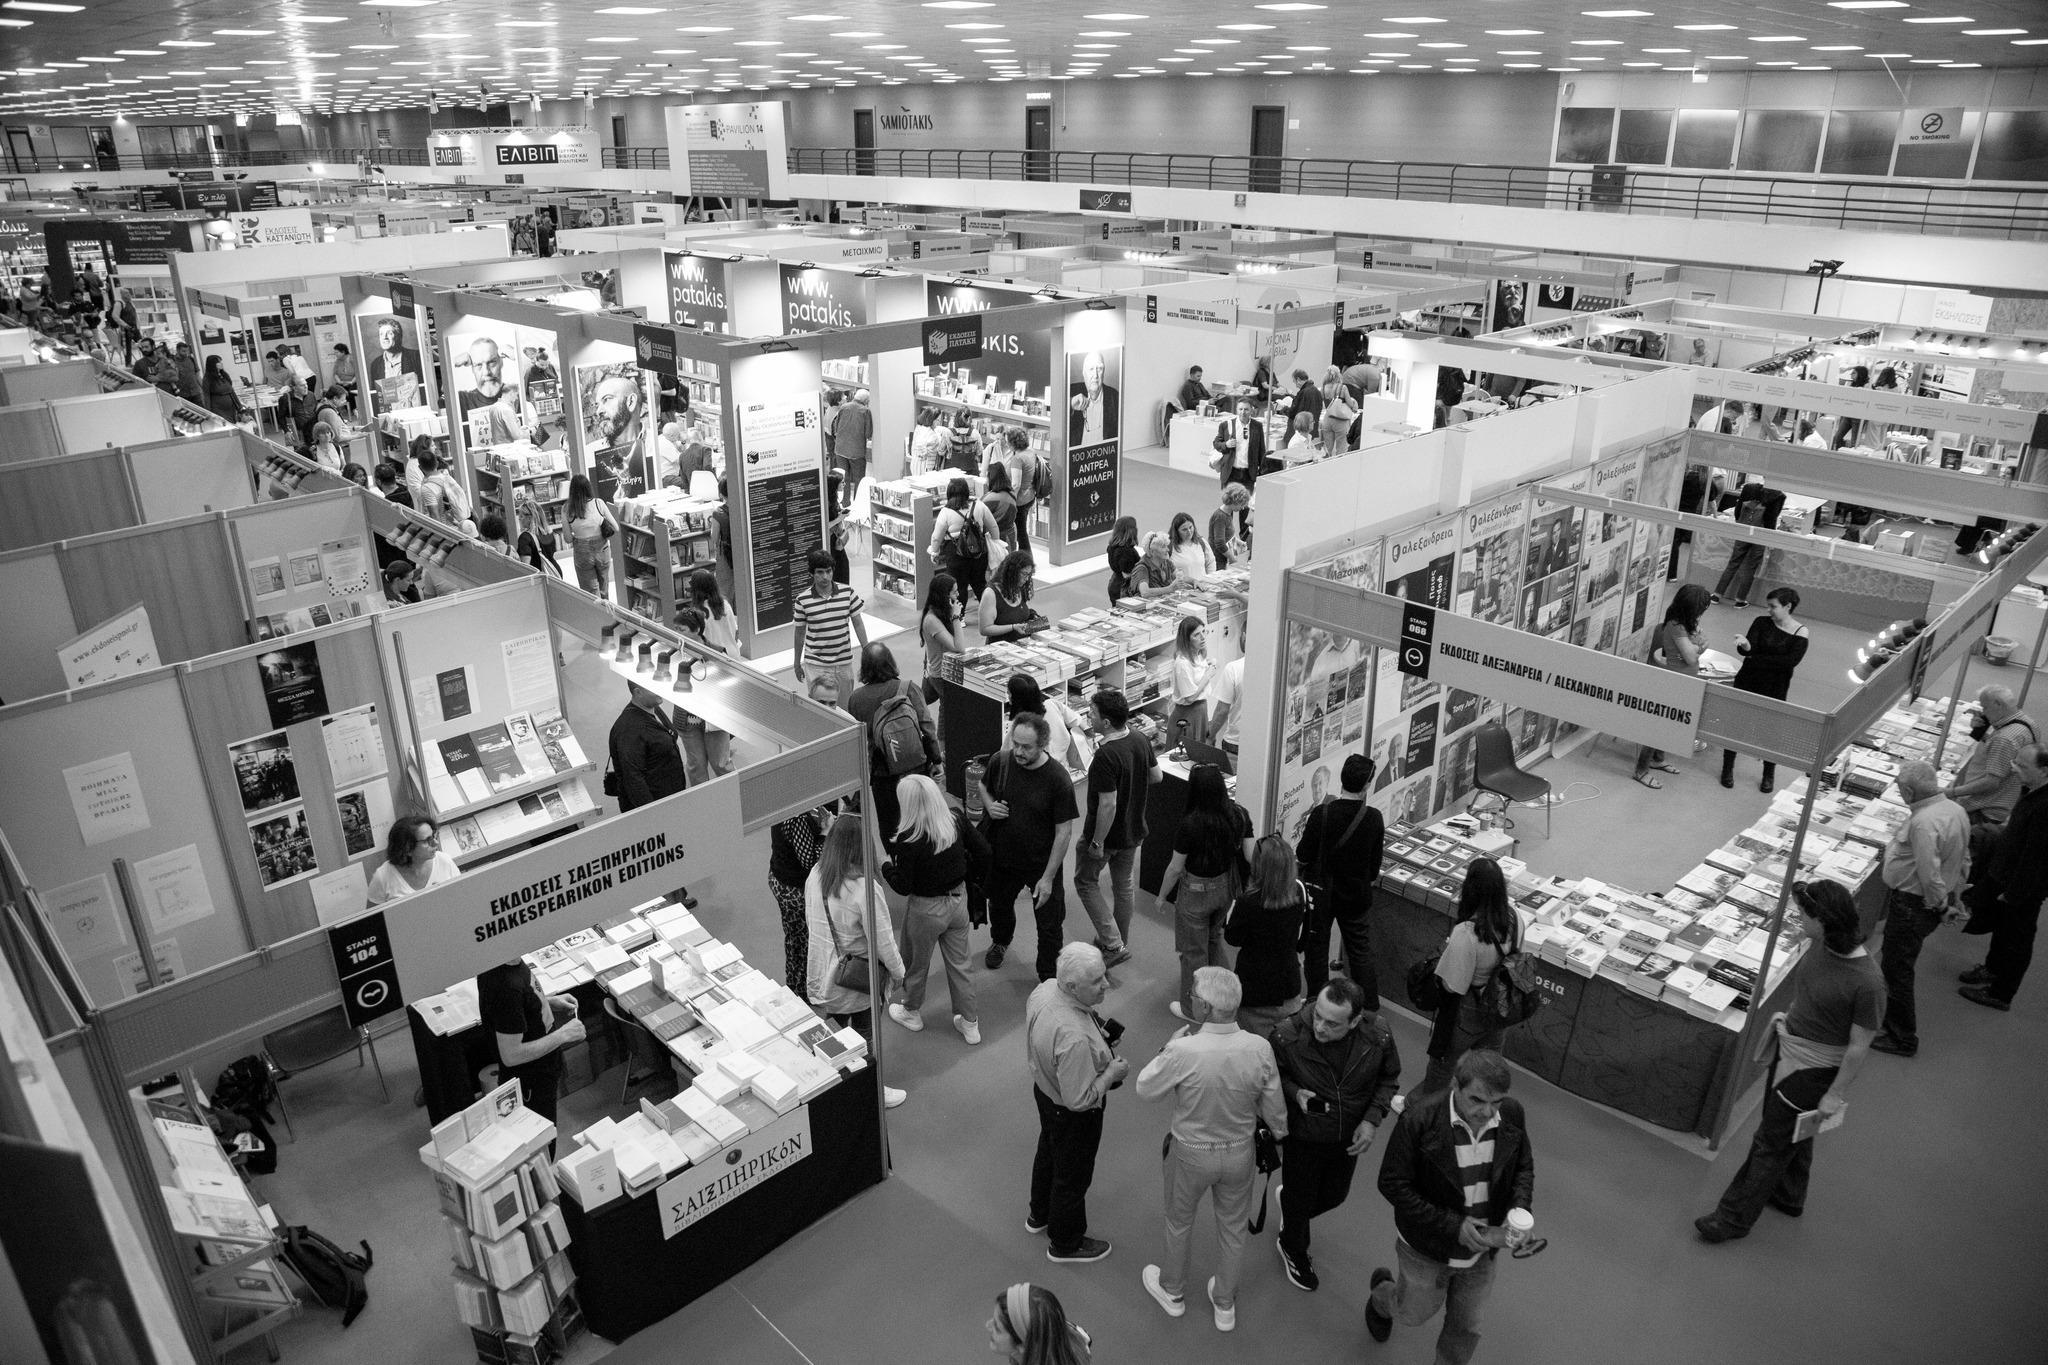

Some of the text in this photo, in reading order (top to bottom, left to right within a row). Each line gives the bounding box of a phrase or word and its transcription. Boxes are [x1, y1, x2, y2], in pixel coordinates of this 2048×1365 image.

[726, 124, 763, 134] PAVILION 14
[880, 114, 933, 130] SAMIOTAKIS
[500, 146, 557, 162] ΕΛΙΒΙΠ
[787, 276, 833, 298] www.
[673, 284, 728, 309] patakis.
[788, 300, 856, 327] patakis.
[949, 337, 976, 347] ΠΑΤΑΚΗ
[1071, 445, 1115, 462] 100 ΧΡΟΝΙΑ
[1079, 459, 1109, 474] ΑΝΤΡΕΑ
[1073, 470, 1114, 488] ΚΑΜΙΛΛΕΡΙ
[1409, 617, 1428, 626] STAND
[1409, 624, 1427, 636] 068
[1439, 642, 1692, 725] ΕΚΔΟΣΕΙΣ ΑΛΕΞΑΝΔΡΕΙΑ / ALEXANDRIA PUBLICATIONS
[490, 832, 666, 916] ΕΚΔΟΣΕΙΣ ΣΑΙΞΠΗΡΙΚΟΝ
[474, 844, 685, 943] SHAKESPEARIKON EDITIONS
[346, 935, 377, 952] STAND
[350, 945, 378, 964] 104
